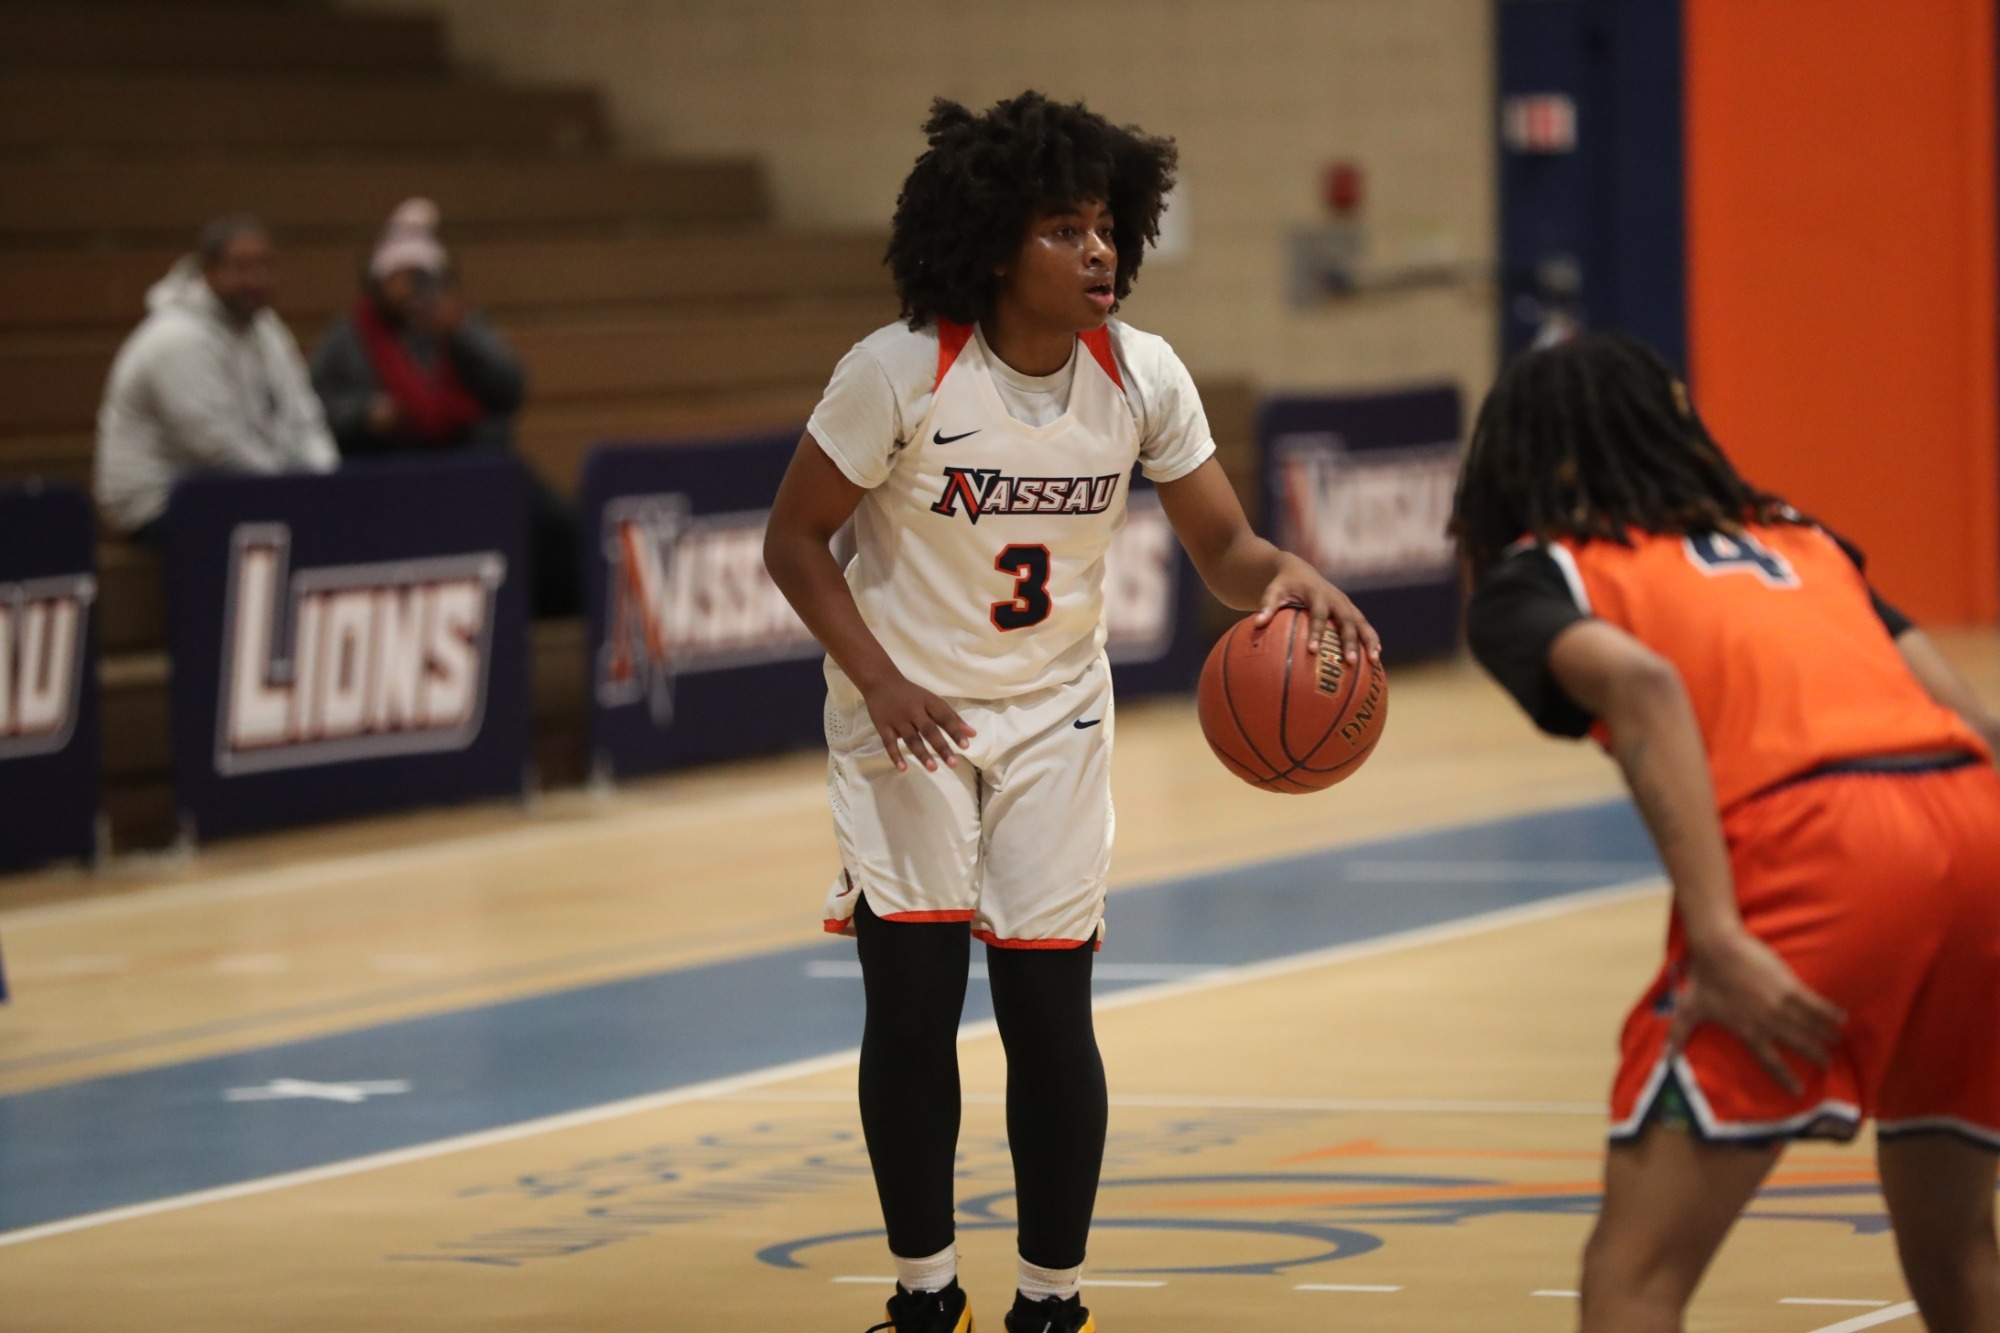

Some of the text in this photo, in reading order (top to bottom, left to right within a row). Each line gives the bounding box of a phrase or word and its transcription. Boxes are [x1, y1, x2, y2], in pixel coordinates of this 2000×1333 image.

[930, 466, 1121, 525] NASSAU
[989, 543, 1052, 632] 3
[213, 521, 508, 778] LIONS
